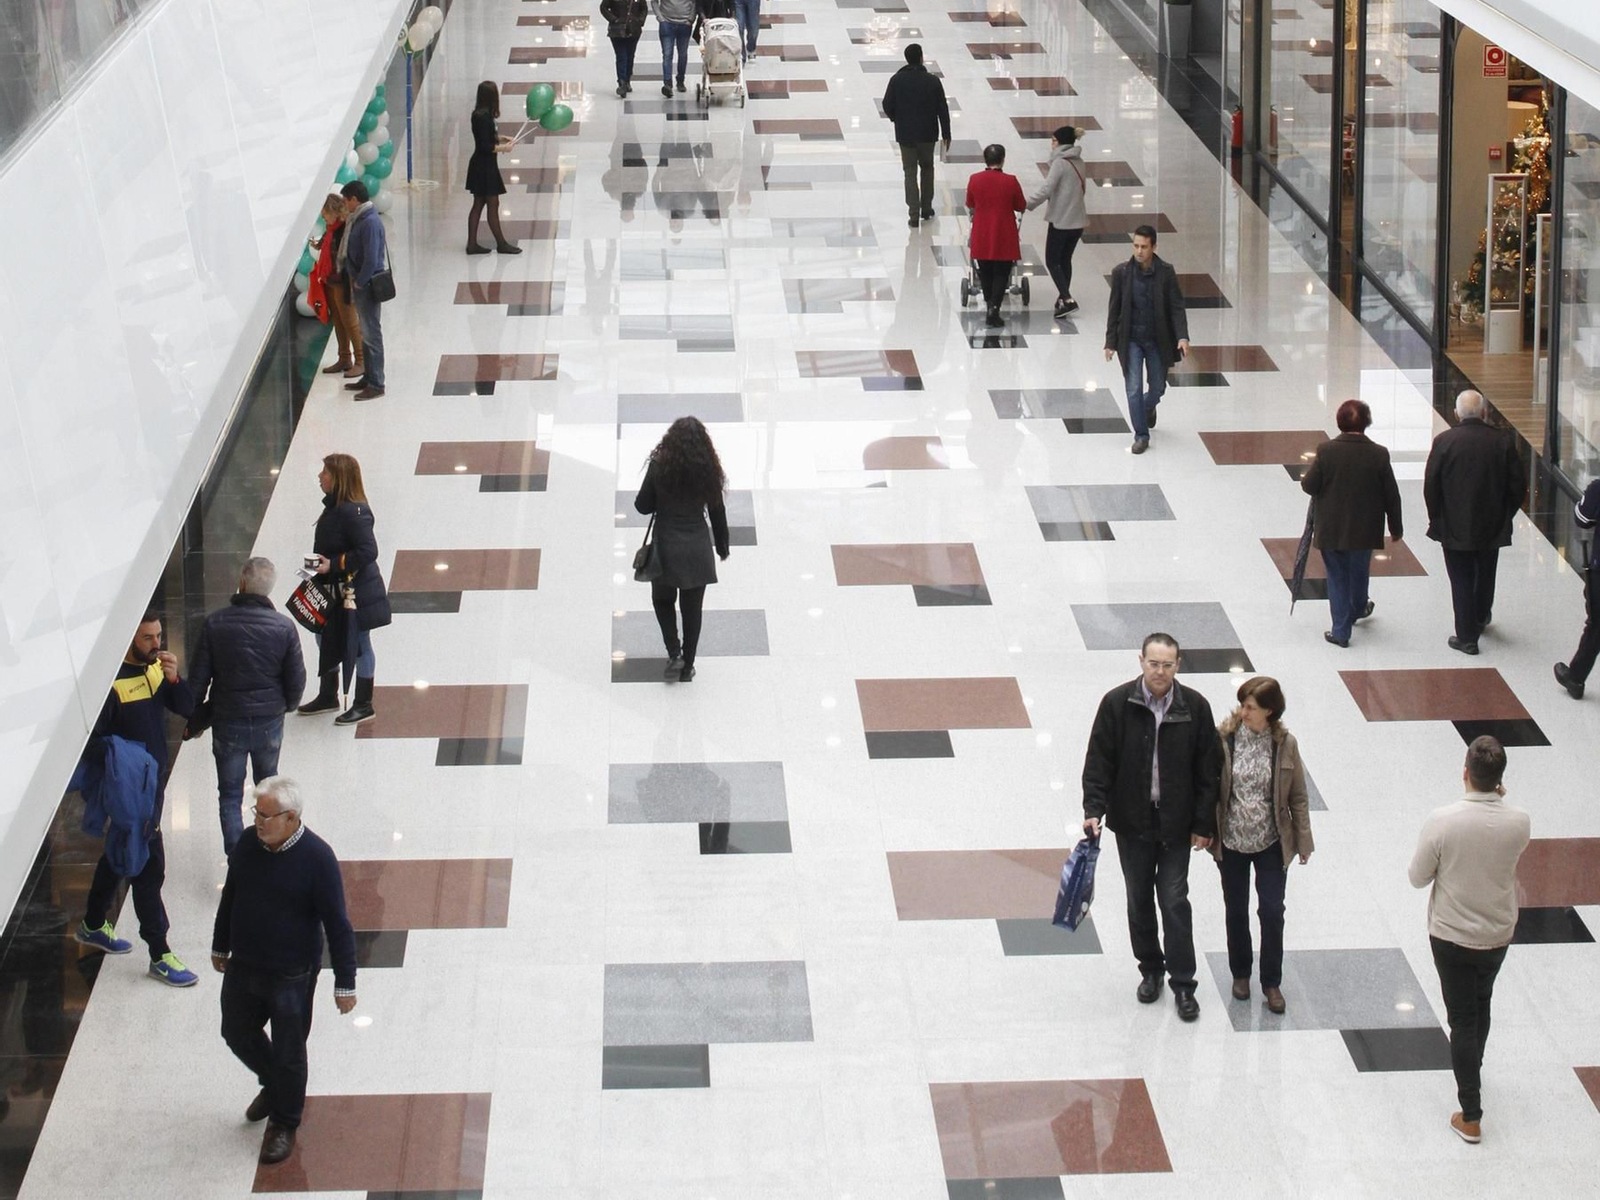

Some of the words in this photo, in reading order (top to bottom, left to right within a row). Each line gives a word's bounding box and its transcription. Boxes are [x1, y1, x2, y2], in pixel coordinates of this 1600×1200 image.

[304, 589, 321, 610] TIENDA
[312, 588, 328, 609] NUEVA
[293, 597, 316, 624] FAVORITA
